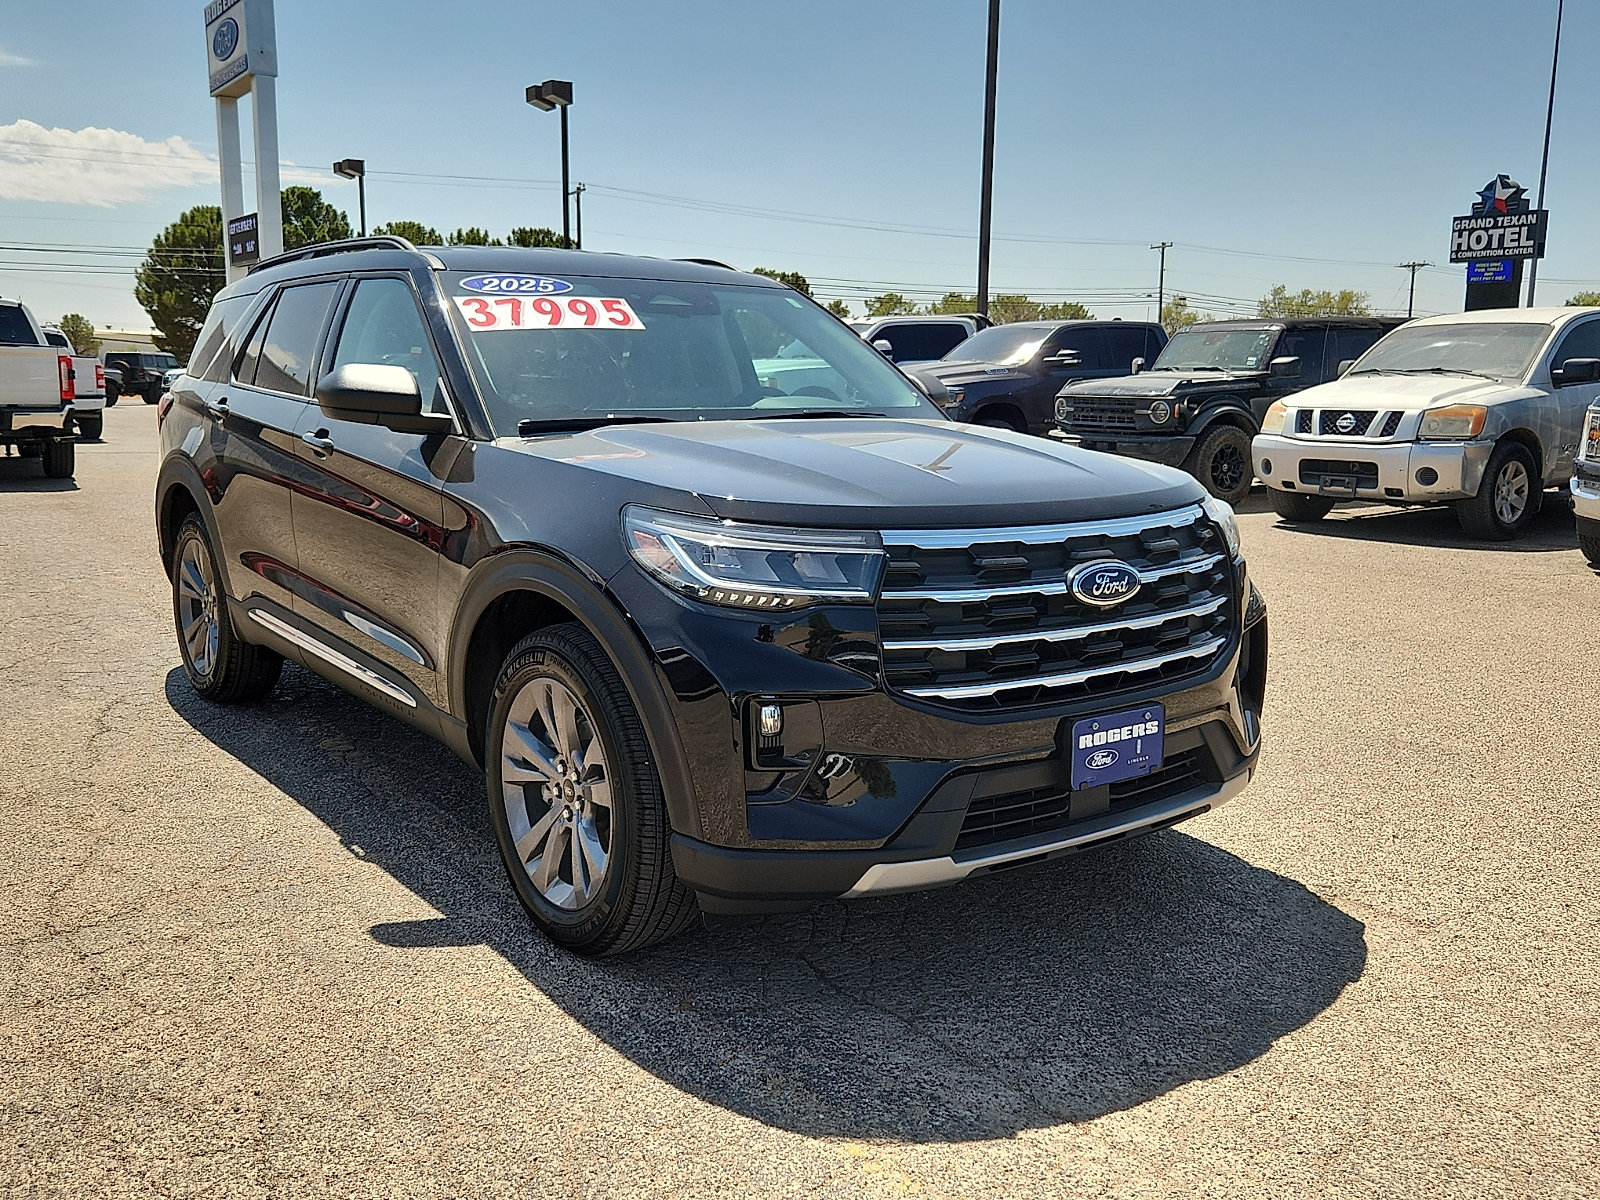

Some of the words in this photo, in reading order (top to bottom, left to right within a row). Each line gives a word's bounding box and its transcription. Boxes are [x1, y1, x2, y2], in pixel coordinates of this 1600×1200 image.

[206, 0, 240, 26] ROGE
[1453, 219, 1494, 231] GRAND
[1496, 213, 1537, 227] TEXAN
[1451, 226, 1534, 251] HOTEL
[1457, 248, 1503, 259] CONVENTION
[1504, 246, 1534, 256] CENTER
[481, 277, 555, 293] 2025
[462, 297, 632, 327] 37995
[1092, 571, 1129, 596] Ford
[507, 651, 544, 679] MICHELIN
[550, 655, 574, 678] PRIMACY
[1078, 720, 1159, 749] ROGERS
[1091, 752, 1113, 767] Ford
